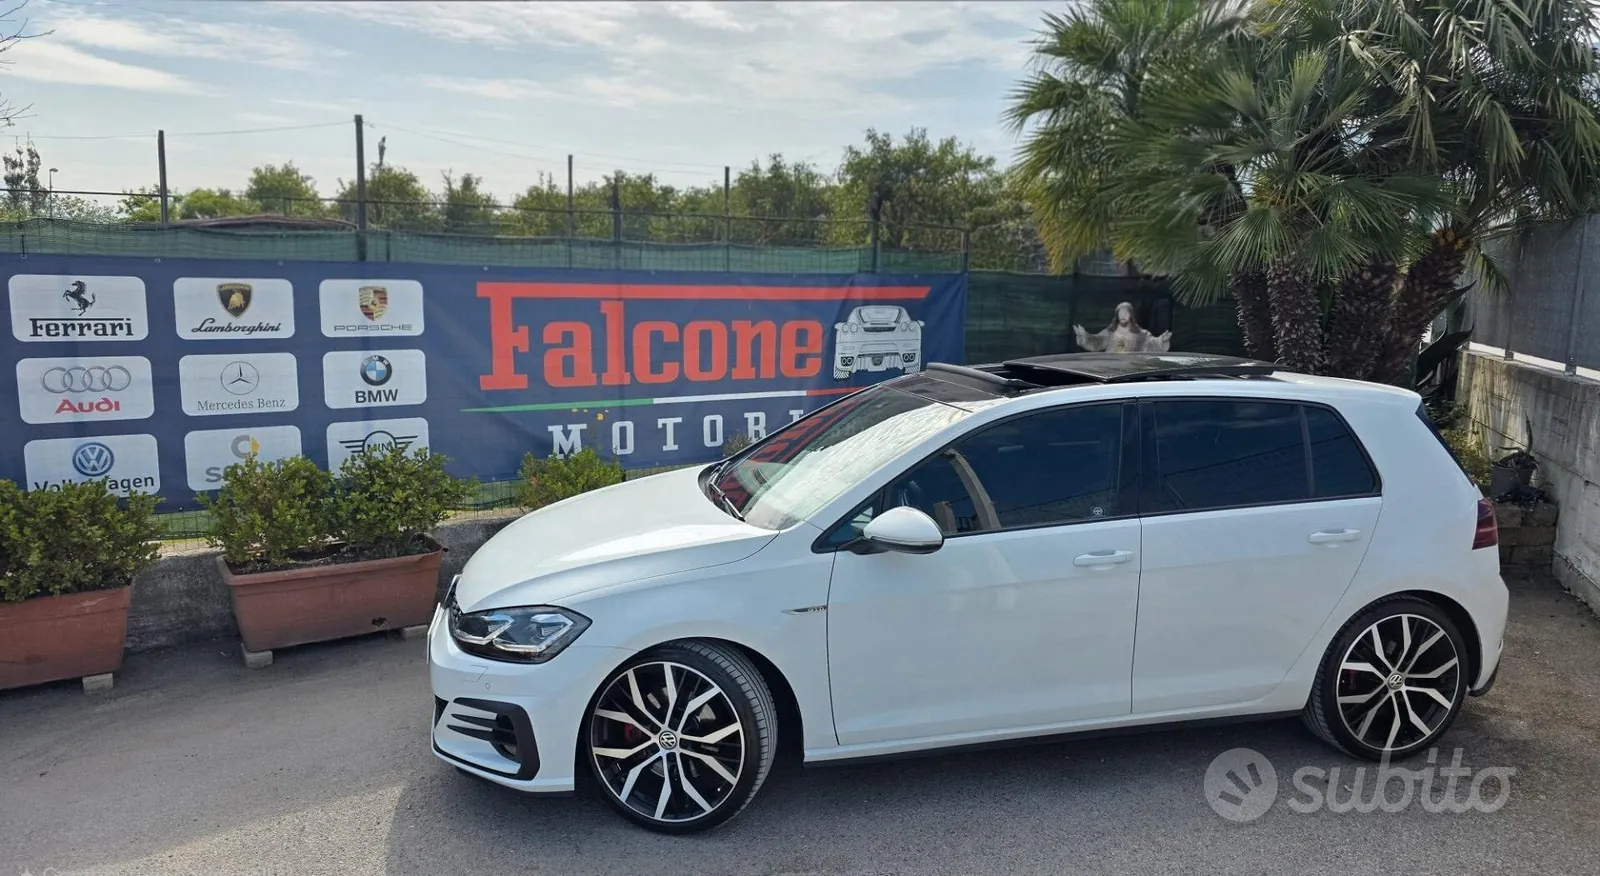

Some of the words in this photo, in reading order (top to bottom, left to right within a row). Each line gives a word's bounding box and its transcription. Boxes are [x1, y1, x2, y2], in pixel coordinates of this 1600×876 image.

[29, 317, 134, 338] Ferrari
[191, 317, 282, 336] Lamborghini
[333, 323, 413, 332] PORSCHE
[476, 281, 824, 391] Falcone
[55, 396, 120, 415] Audi
[197, 397, 254, 412] Mercedes
[258, 396, 286, 410] Benz
[354, 388, 399, 404] BMW
